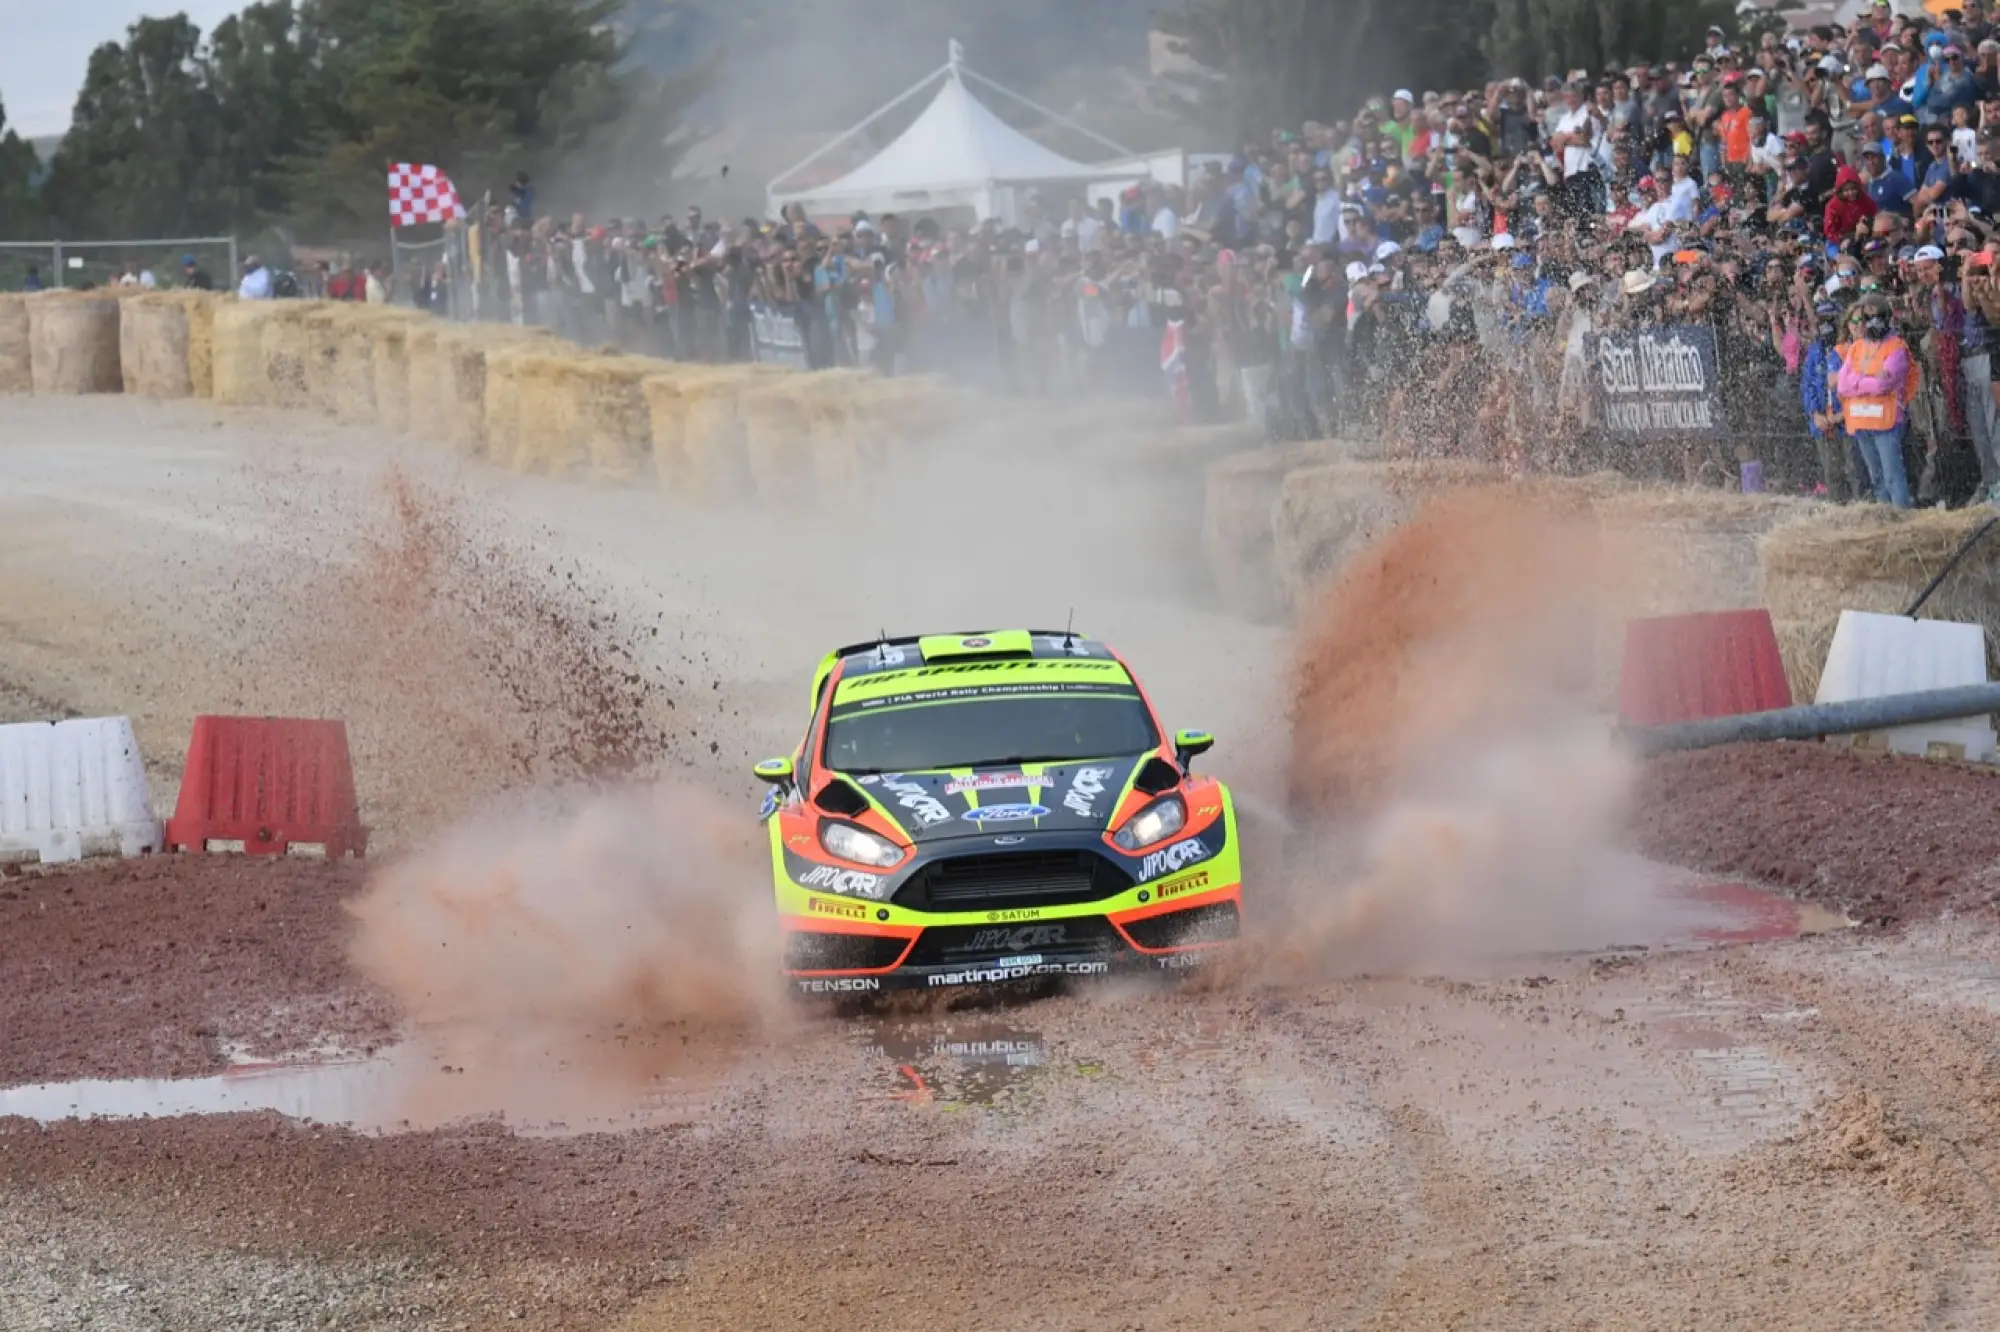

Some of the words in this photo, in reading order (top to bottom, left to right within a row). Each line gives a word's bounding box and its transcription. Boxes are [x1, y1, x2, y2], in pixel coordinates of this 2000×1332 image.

[1600, 336, 1639, 393] San
[1639, 333, 1704, 392] Martino
[915, 691, 948, 700] World
[951, 687, 978, 696] Rally
[981, 684, 1058, 693] Championship
[1138, 837, 1204, 882] JIPOCAR
[799, 865, 877, 895] JIPOCAR
[1157, 870, 1209, 898] PIRELLI
[808, 897, 867, 920] PIRELLI
[1001, 909, 1040, 921] SATUM
[964, 923, 1068, 952] JIPOCAR
[798, 977, 880, 994] TENSON
